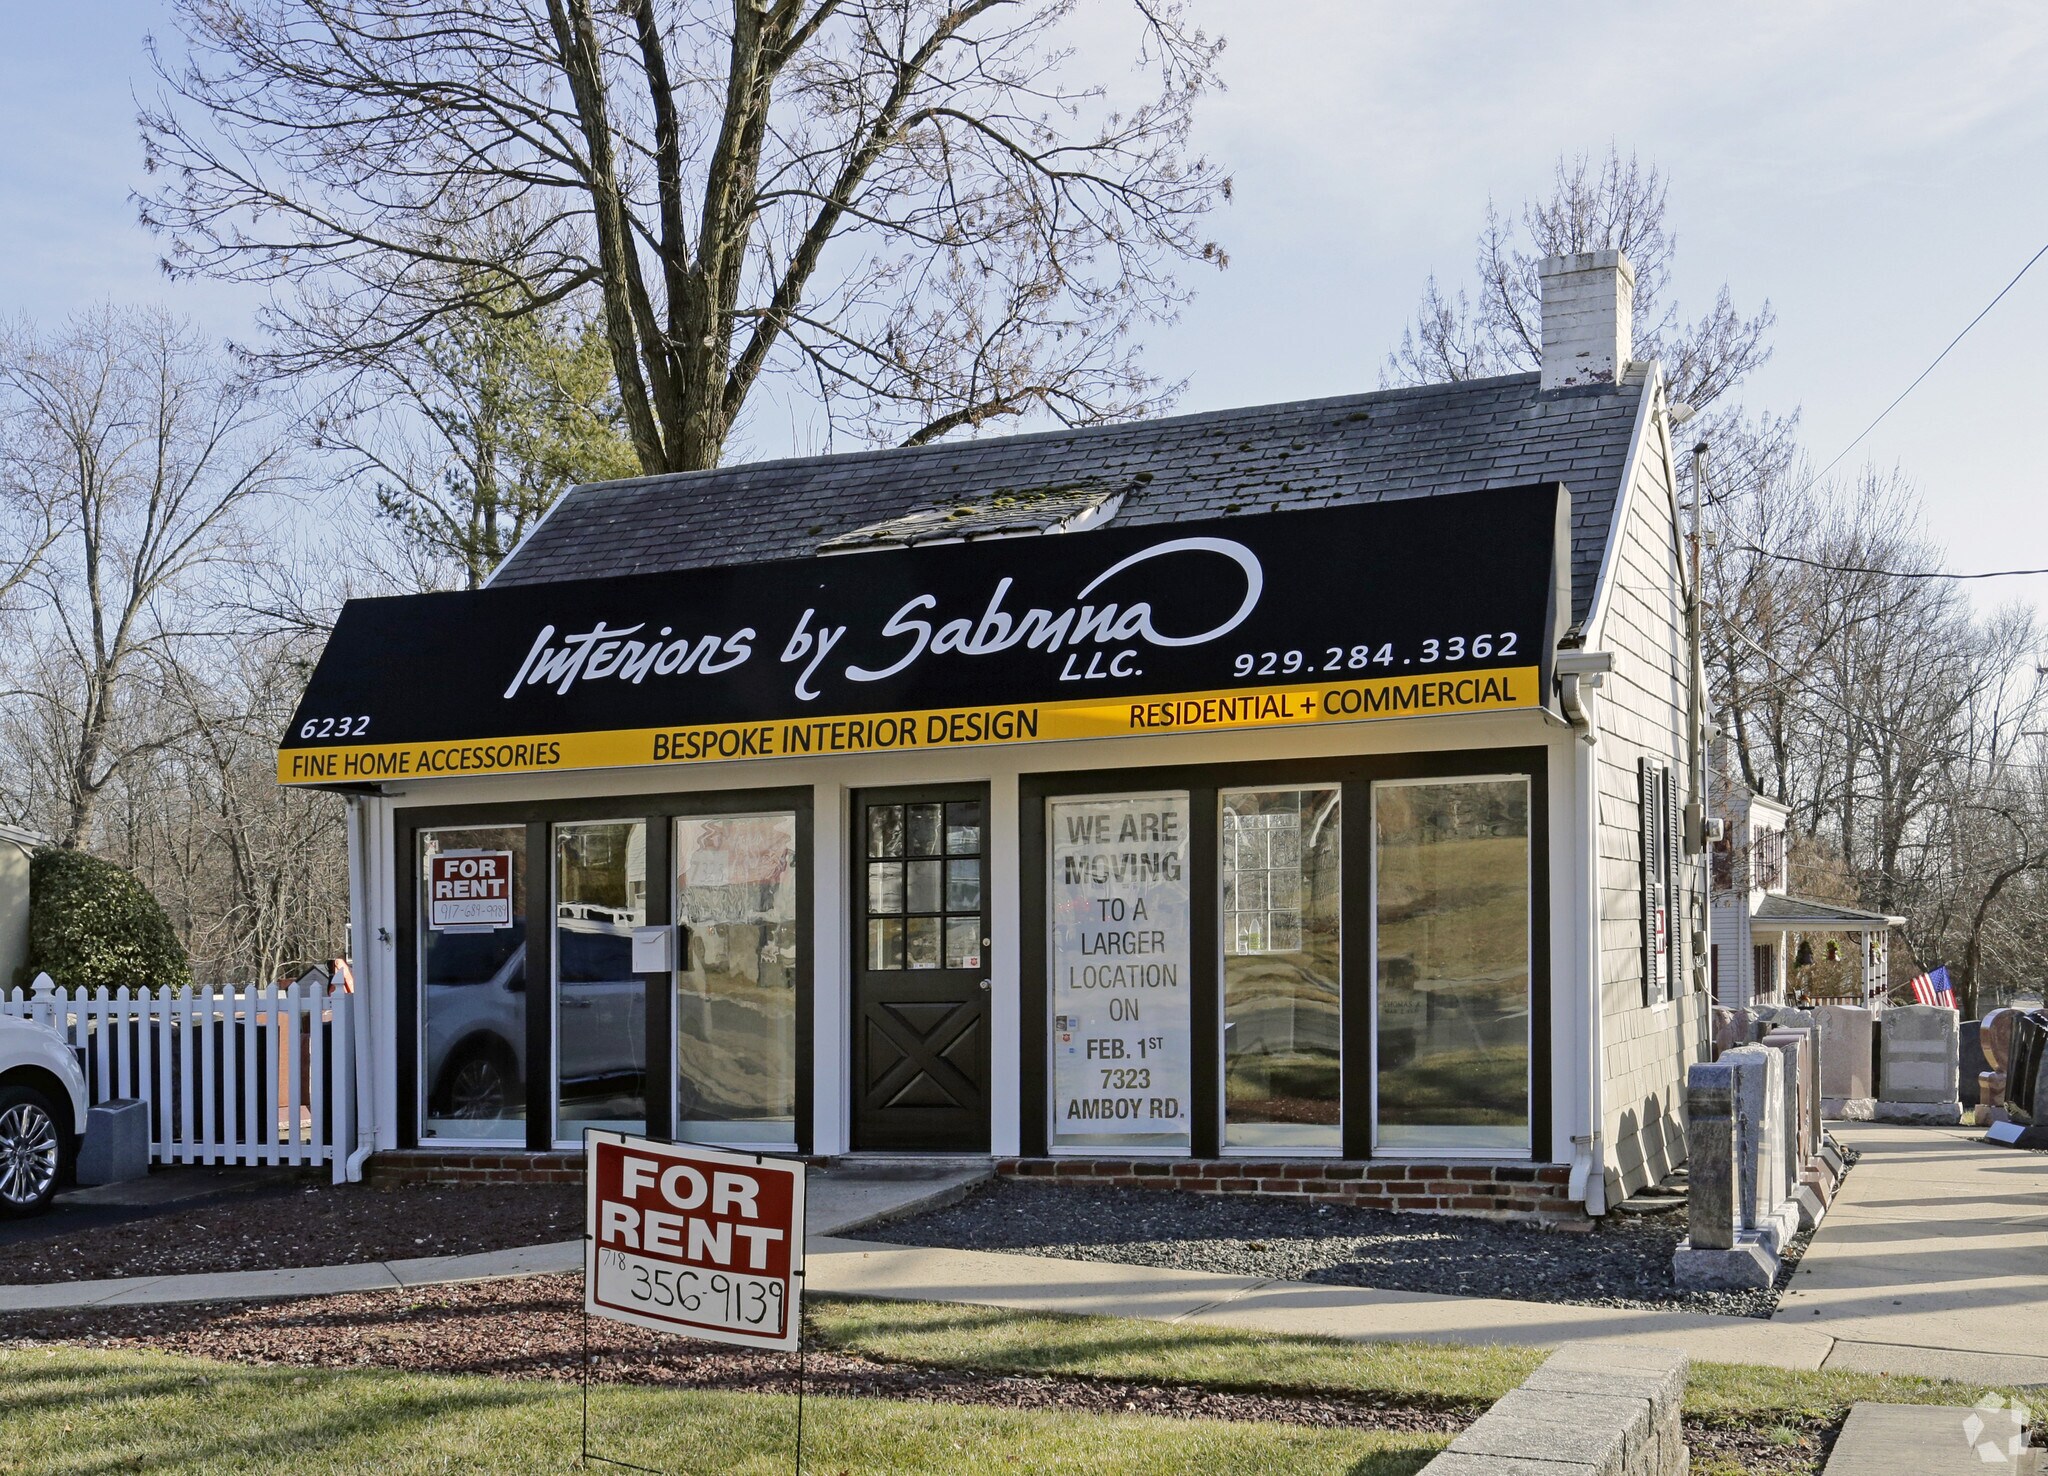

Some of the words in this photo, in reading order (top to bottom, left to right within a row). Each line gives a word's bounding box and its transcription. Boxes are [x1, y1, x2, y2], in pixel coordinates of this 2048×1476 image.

[503, 621, 757, 700] Interiors
[780, 608, 847, 701] by
[844, 536, 1264, 683] Sabrina
[1059, 649, 1143, 682] LLC.
[1233, 632, 1518, 678] 929.284.3362
[1129, 693, 1293, 728] RESIDENTIAL
[1323, 676, 1516, 716] COMMERCIAL
[300, 715, 371, 739] 6232
[653, 726, 774, 760] BESPOKE
[782, 717, 917, 753] INTERIOR
[926, 708, 1039, 744] DESIGN
[292, 754, 338, 777] FINE
[344, 751, 410, 775] HOME
[415, 741, 561, 773] ACCESSORIES
[1066, 814, 1111, 845] WE
[1118, 811, 1178, 843] ARE
[444, 859, 496, 878] FOR
[1064, 851, 1181, 885] MOVING
[436, 879, 505, 898] RENT
[1096, 897, 1125, 922] TO
[1132, 897, 1148, 922] A
[1081, 930, 1165, 956] LARGER
[1069, 963, 1177, 989] LOCATION
[1109, 998, 1139, 1022] ON
[1086, 1038, 1131, 1060] FEB.
[1100, 1068, 1151, 1090] 7323
[1066, 1097, 1143, 1120] AMBOY
[1149, 1097, 1185, 1119] RD.
[622, 1155, 760, 1219] FOR
[601, 1199, 784, 1270] RENT
[602, 1248, 626, 1271] 718
[630, 1264, 783, 1333] 356-9139
